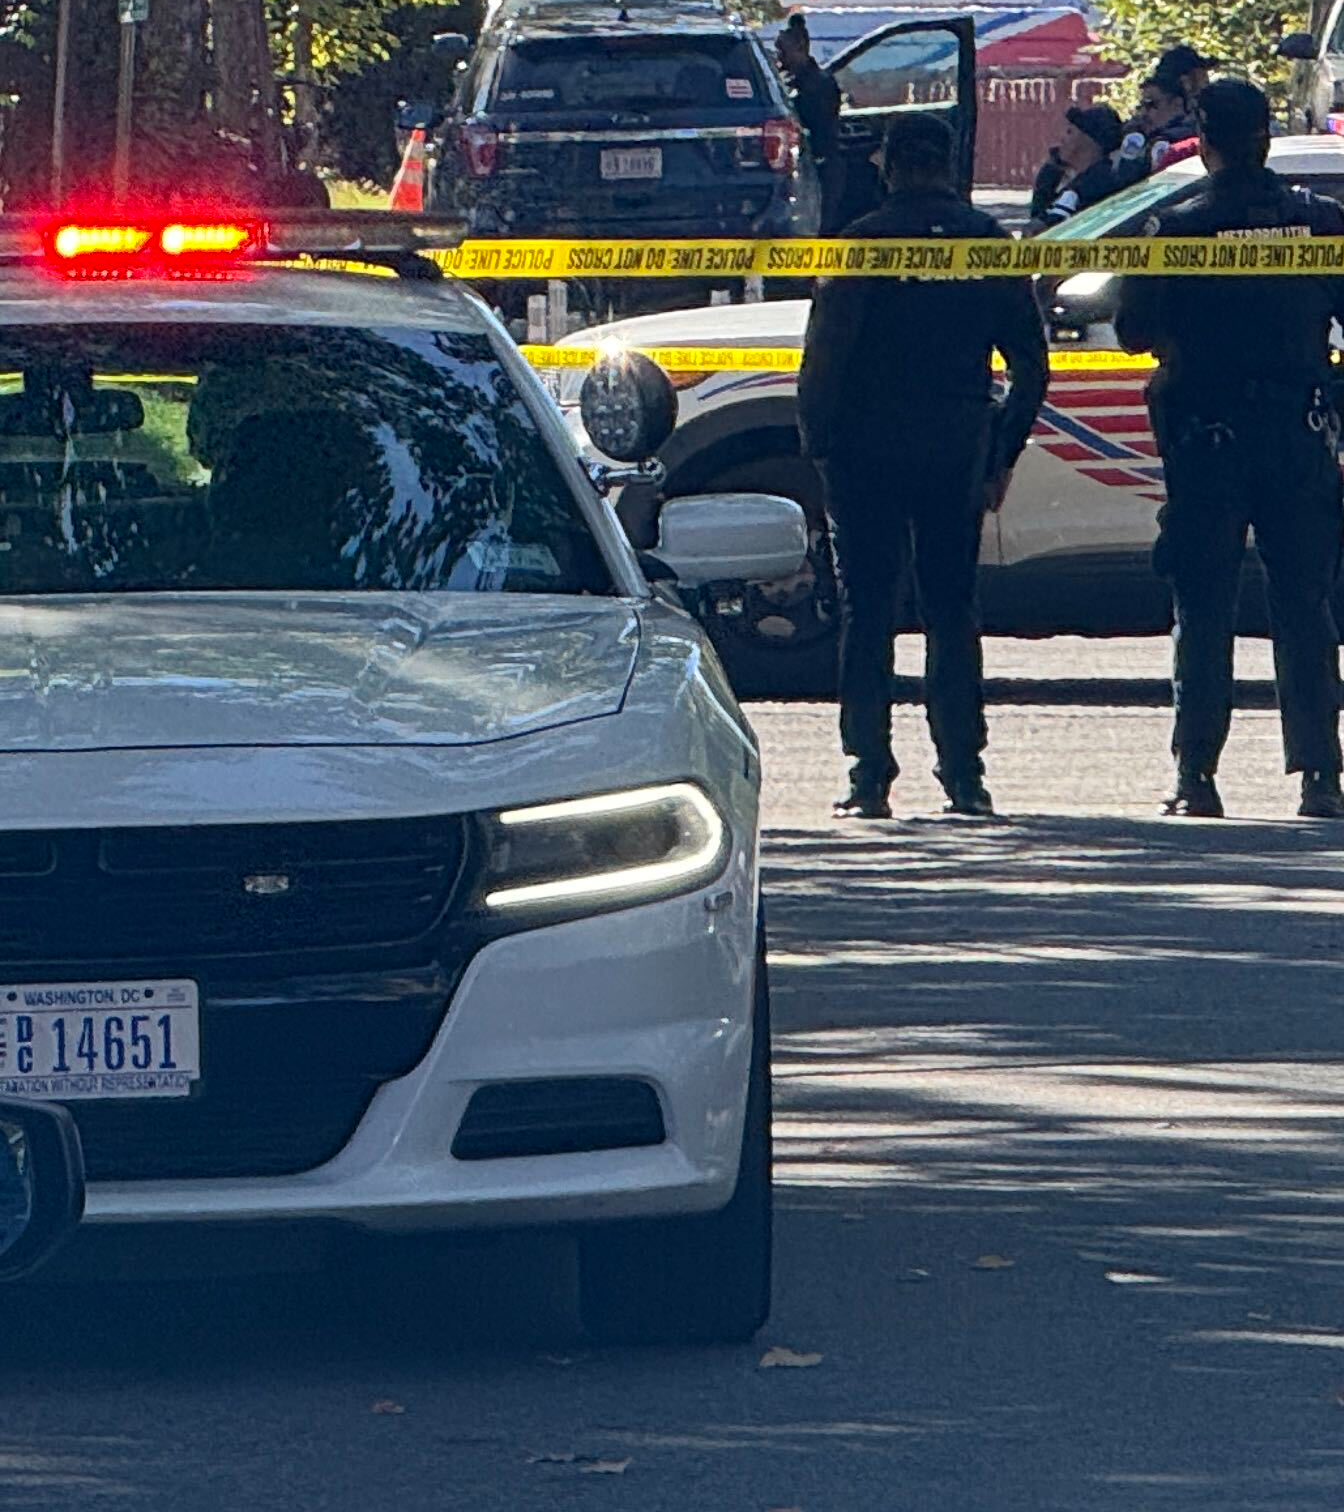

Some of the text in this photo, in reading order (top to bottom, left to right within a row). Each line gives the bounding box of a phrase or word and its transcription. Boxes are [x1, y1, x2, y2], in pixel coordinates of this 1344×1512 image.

[443, 250, 462, 269] DO
[503, 248, 554, 270] POLICE
[567, 248, 609, 270] CROSS
[614, 248, 644, 270] NOT
[646, 248, 665, 270] DO
[705, 247, 755, 269] POLICE
[767, 246, 812, 269] CROSS
[814, 247, 843, 269] NOT
[846, 247, 865, 269] DO
[904, 246, 952, 269] POLICE
[967, 246, 1011, 269] CROSS
[1013, 246, 1042, 269] NOT
[1043, 246, 1062, 268] DO
[1101, 246, 1150, 268] POLICE
[1164, 244, 1207, 267] CROSS
[1209, 245, 1236, 267] NOT
[1239, 245, 1258, 267] DO
[1298, 244, 1344, 267] POLICE
[121, 988, 140, 1004] DC
[17, 1015, 33, 1043] D
[52, 1014, 177, 1072] 14651
[17, 1045, 33, 1073] C
